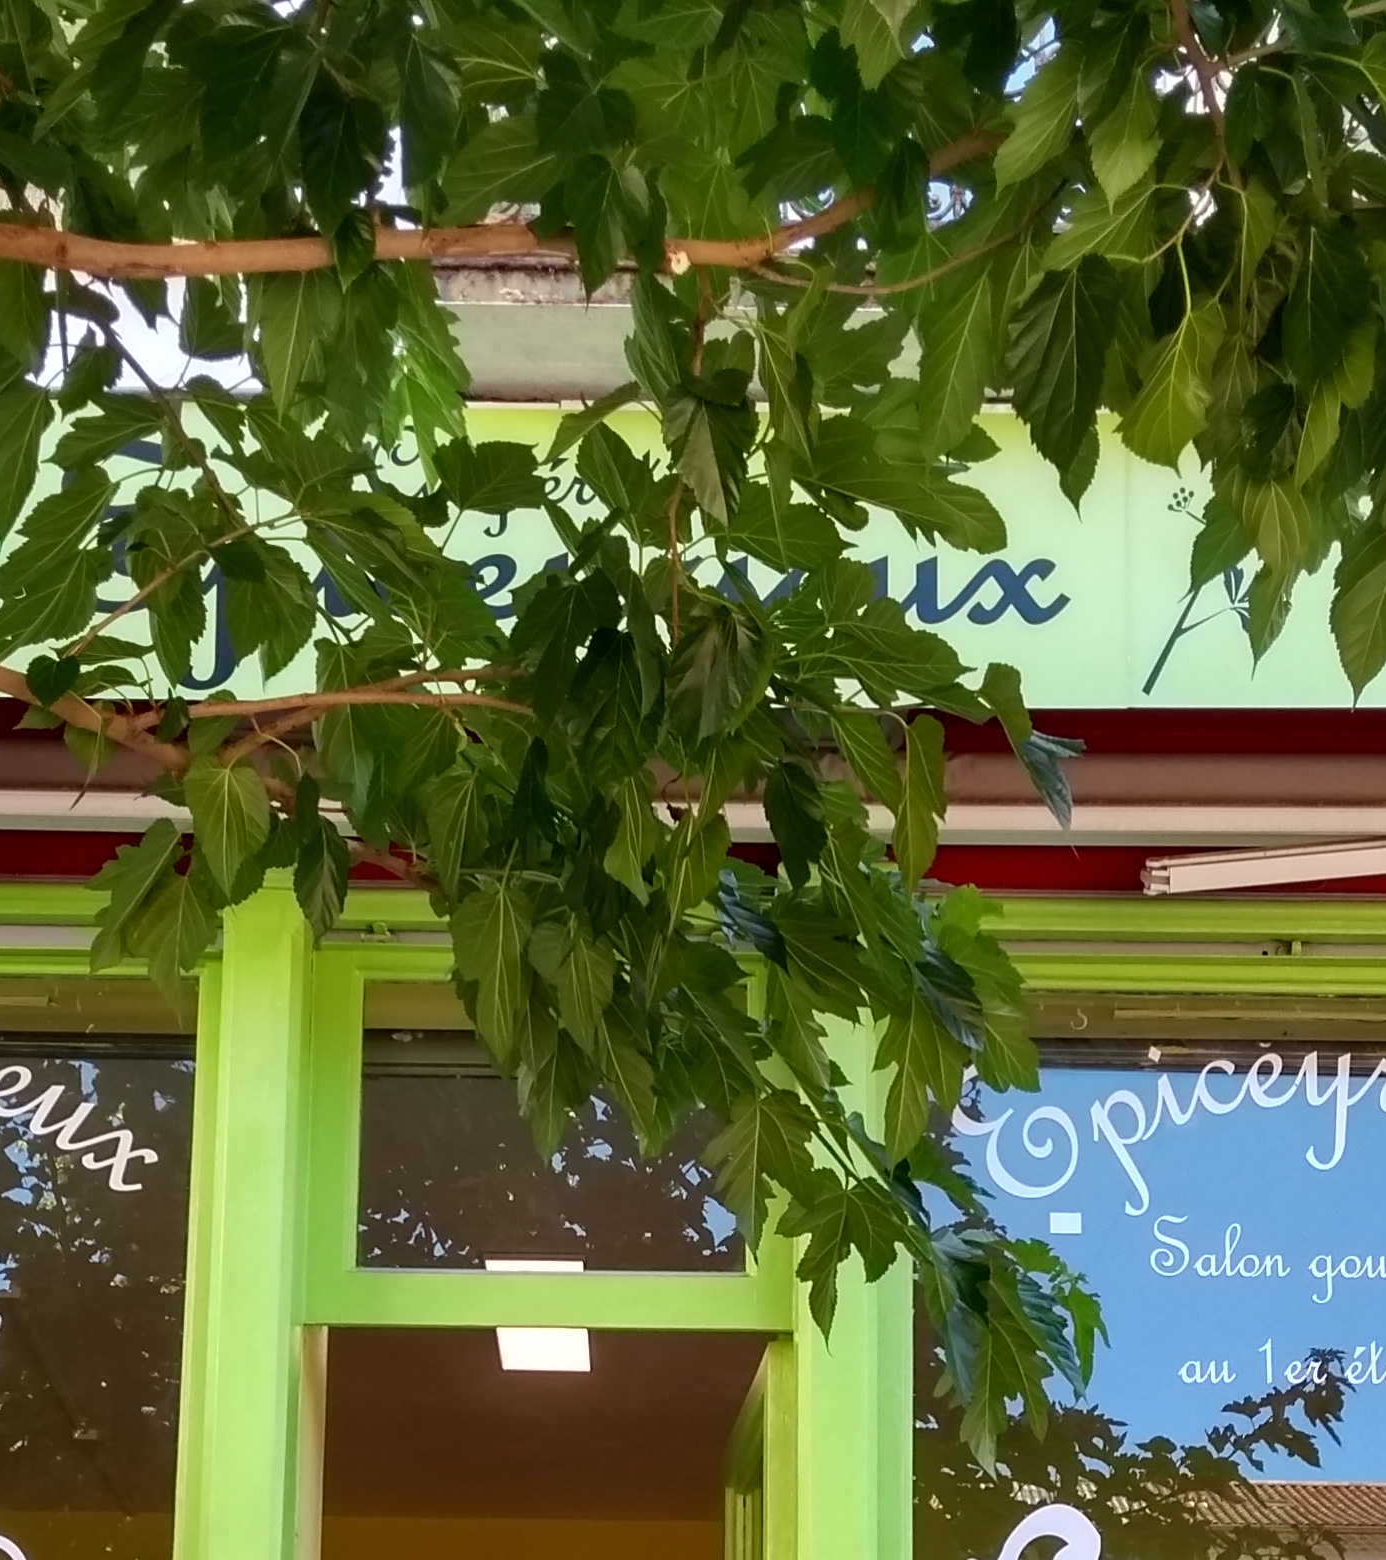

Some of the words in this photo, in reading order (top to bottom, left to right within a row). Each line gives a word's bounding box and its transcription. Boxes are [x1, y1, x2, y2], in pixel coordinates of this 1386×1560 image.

[1150, 1215, 1291, 1280] Salon
[1178, 1359, 1236, 1385] au
[1257, 1338, 1328, 1386] 1er
